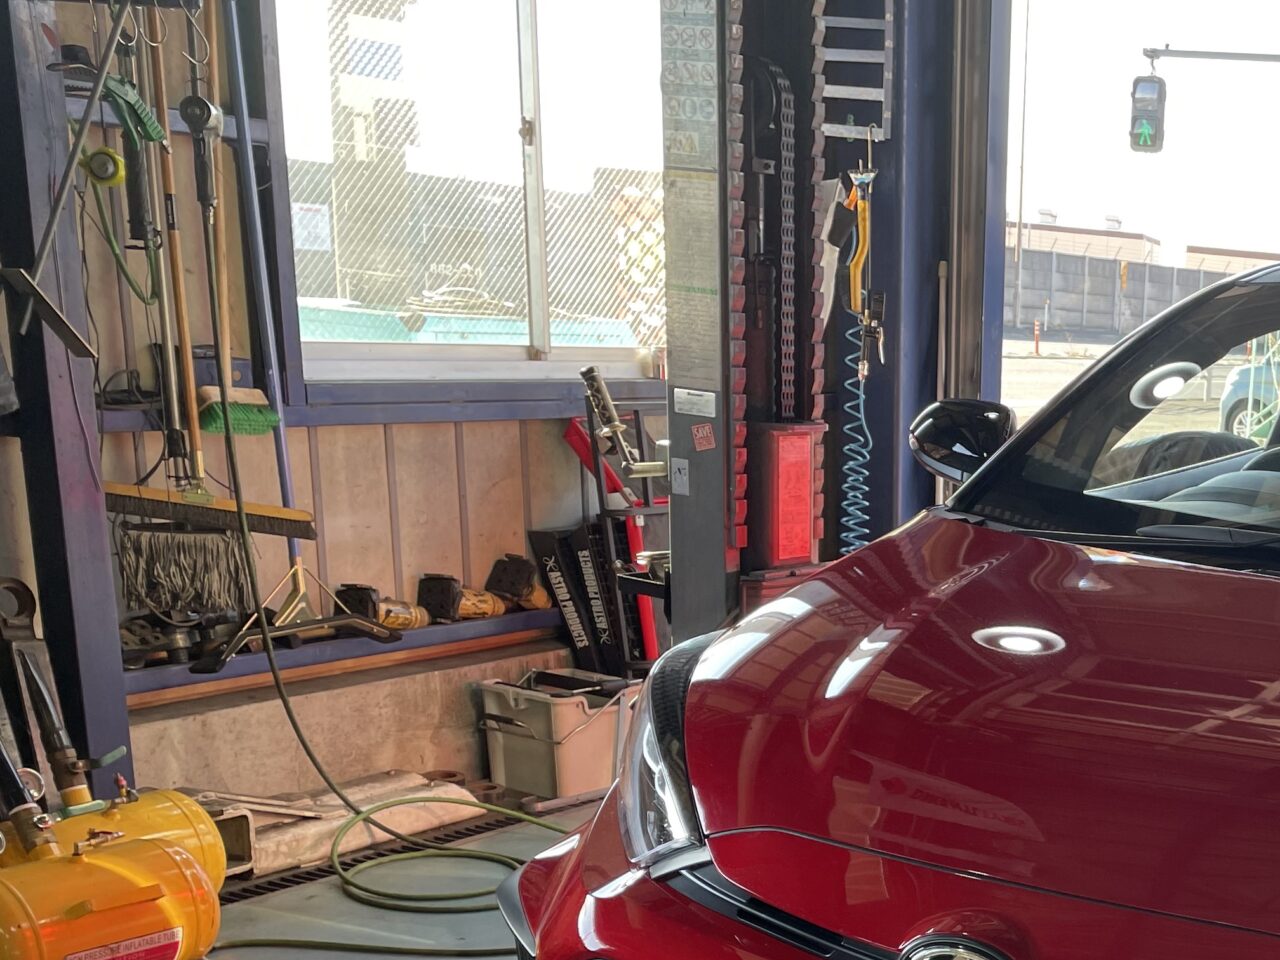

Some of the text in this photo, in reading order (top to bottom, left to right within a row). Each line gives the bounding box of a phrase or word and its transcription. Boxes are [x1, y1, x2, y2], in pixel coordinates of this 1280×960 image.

[694, 425, 712, 439] SAVE
[547, 571, 590, 649] ASTRO PRODUCTS
[578, 549, 609, 630] ASTRO PRODUCTS
